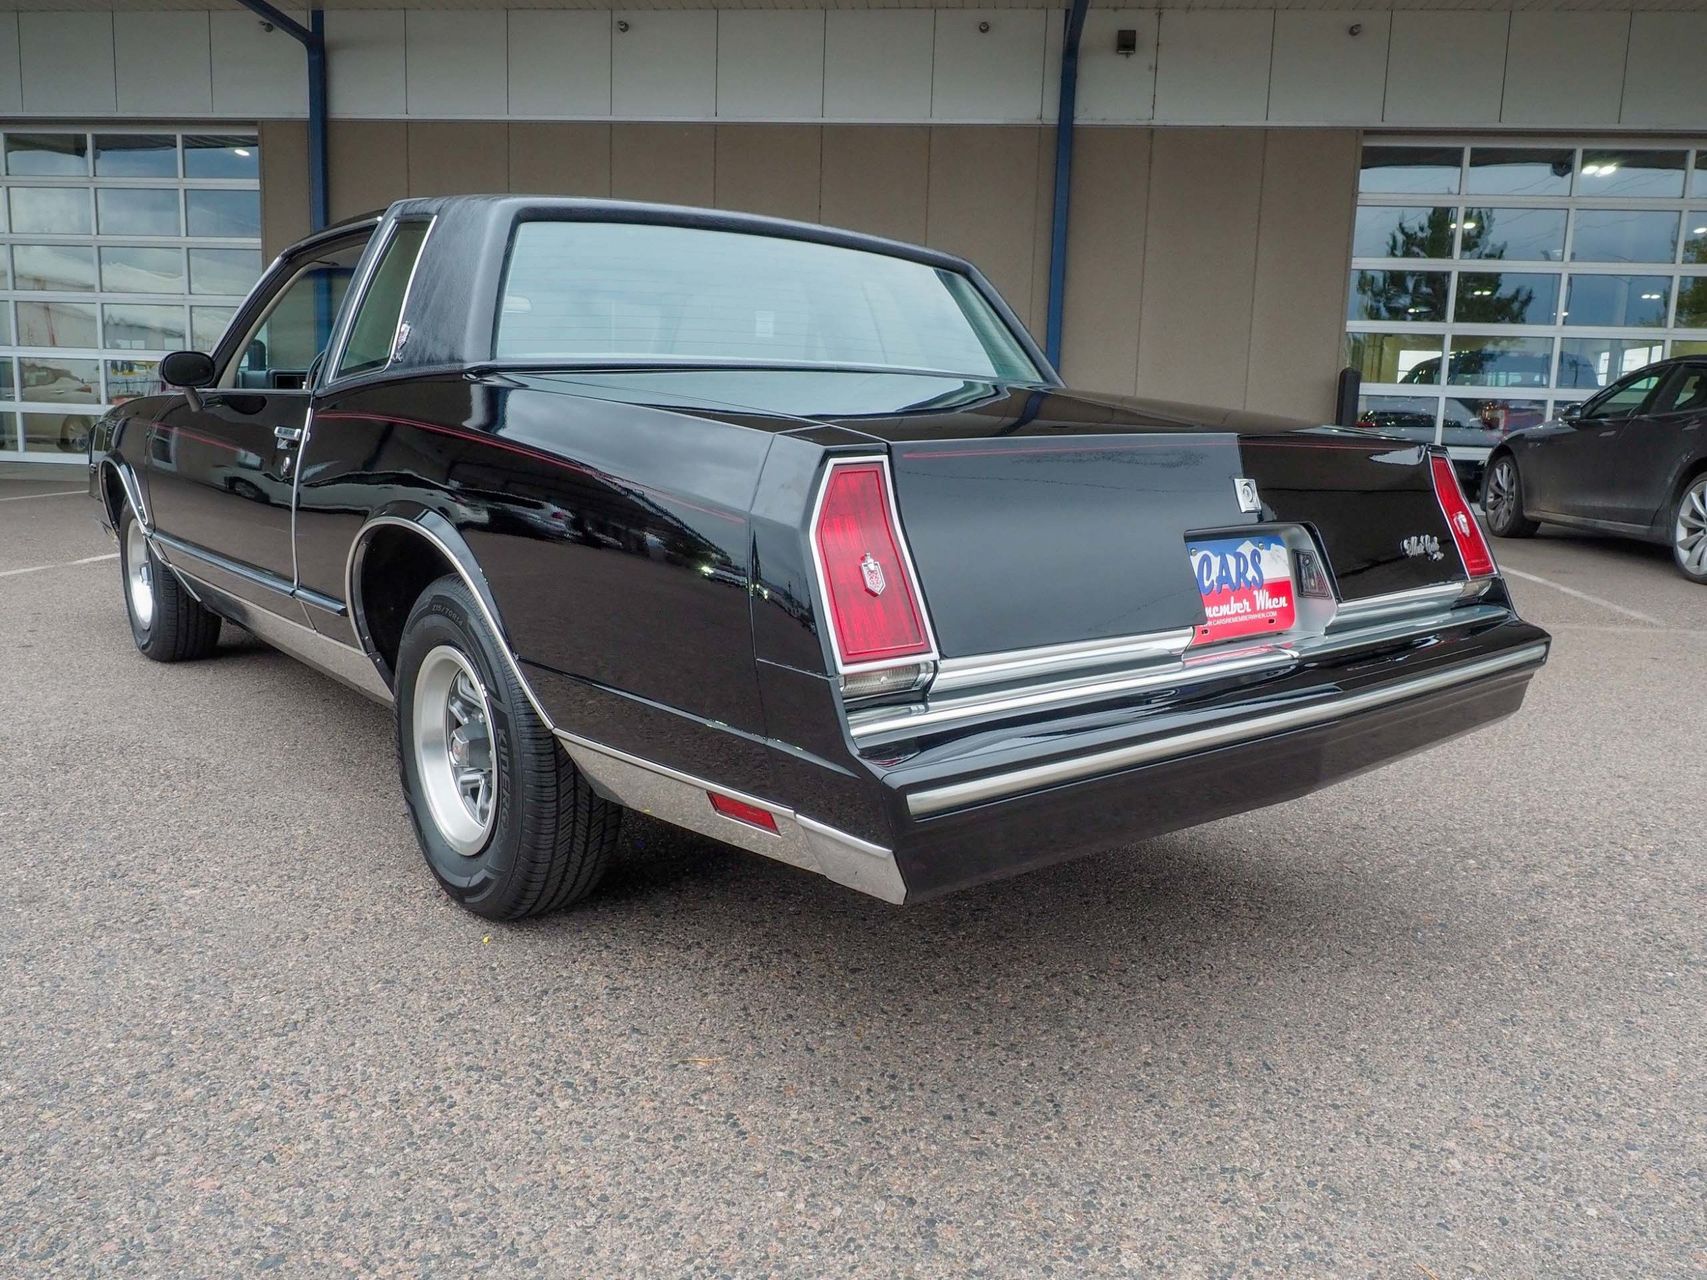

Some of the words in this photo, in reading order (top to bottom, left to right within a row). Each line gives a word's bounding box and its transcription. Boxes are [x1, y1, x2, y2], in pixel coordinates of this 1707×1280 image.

[1197, 549, 1264, 595] CARS
[1205, 596, 1251, 618] member
[1253, 589, 1288, 611] When
